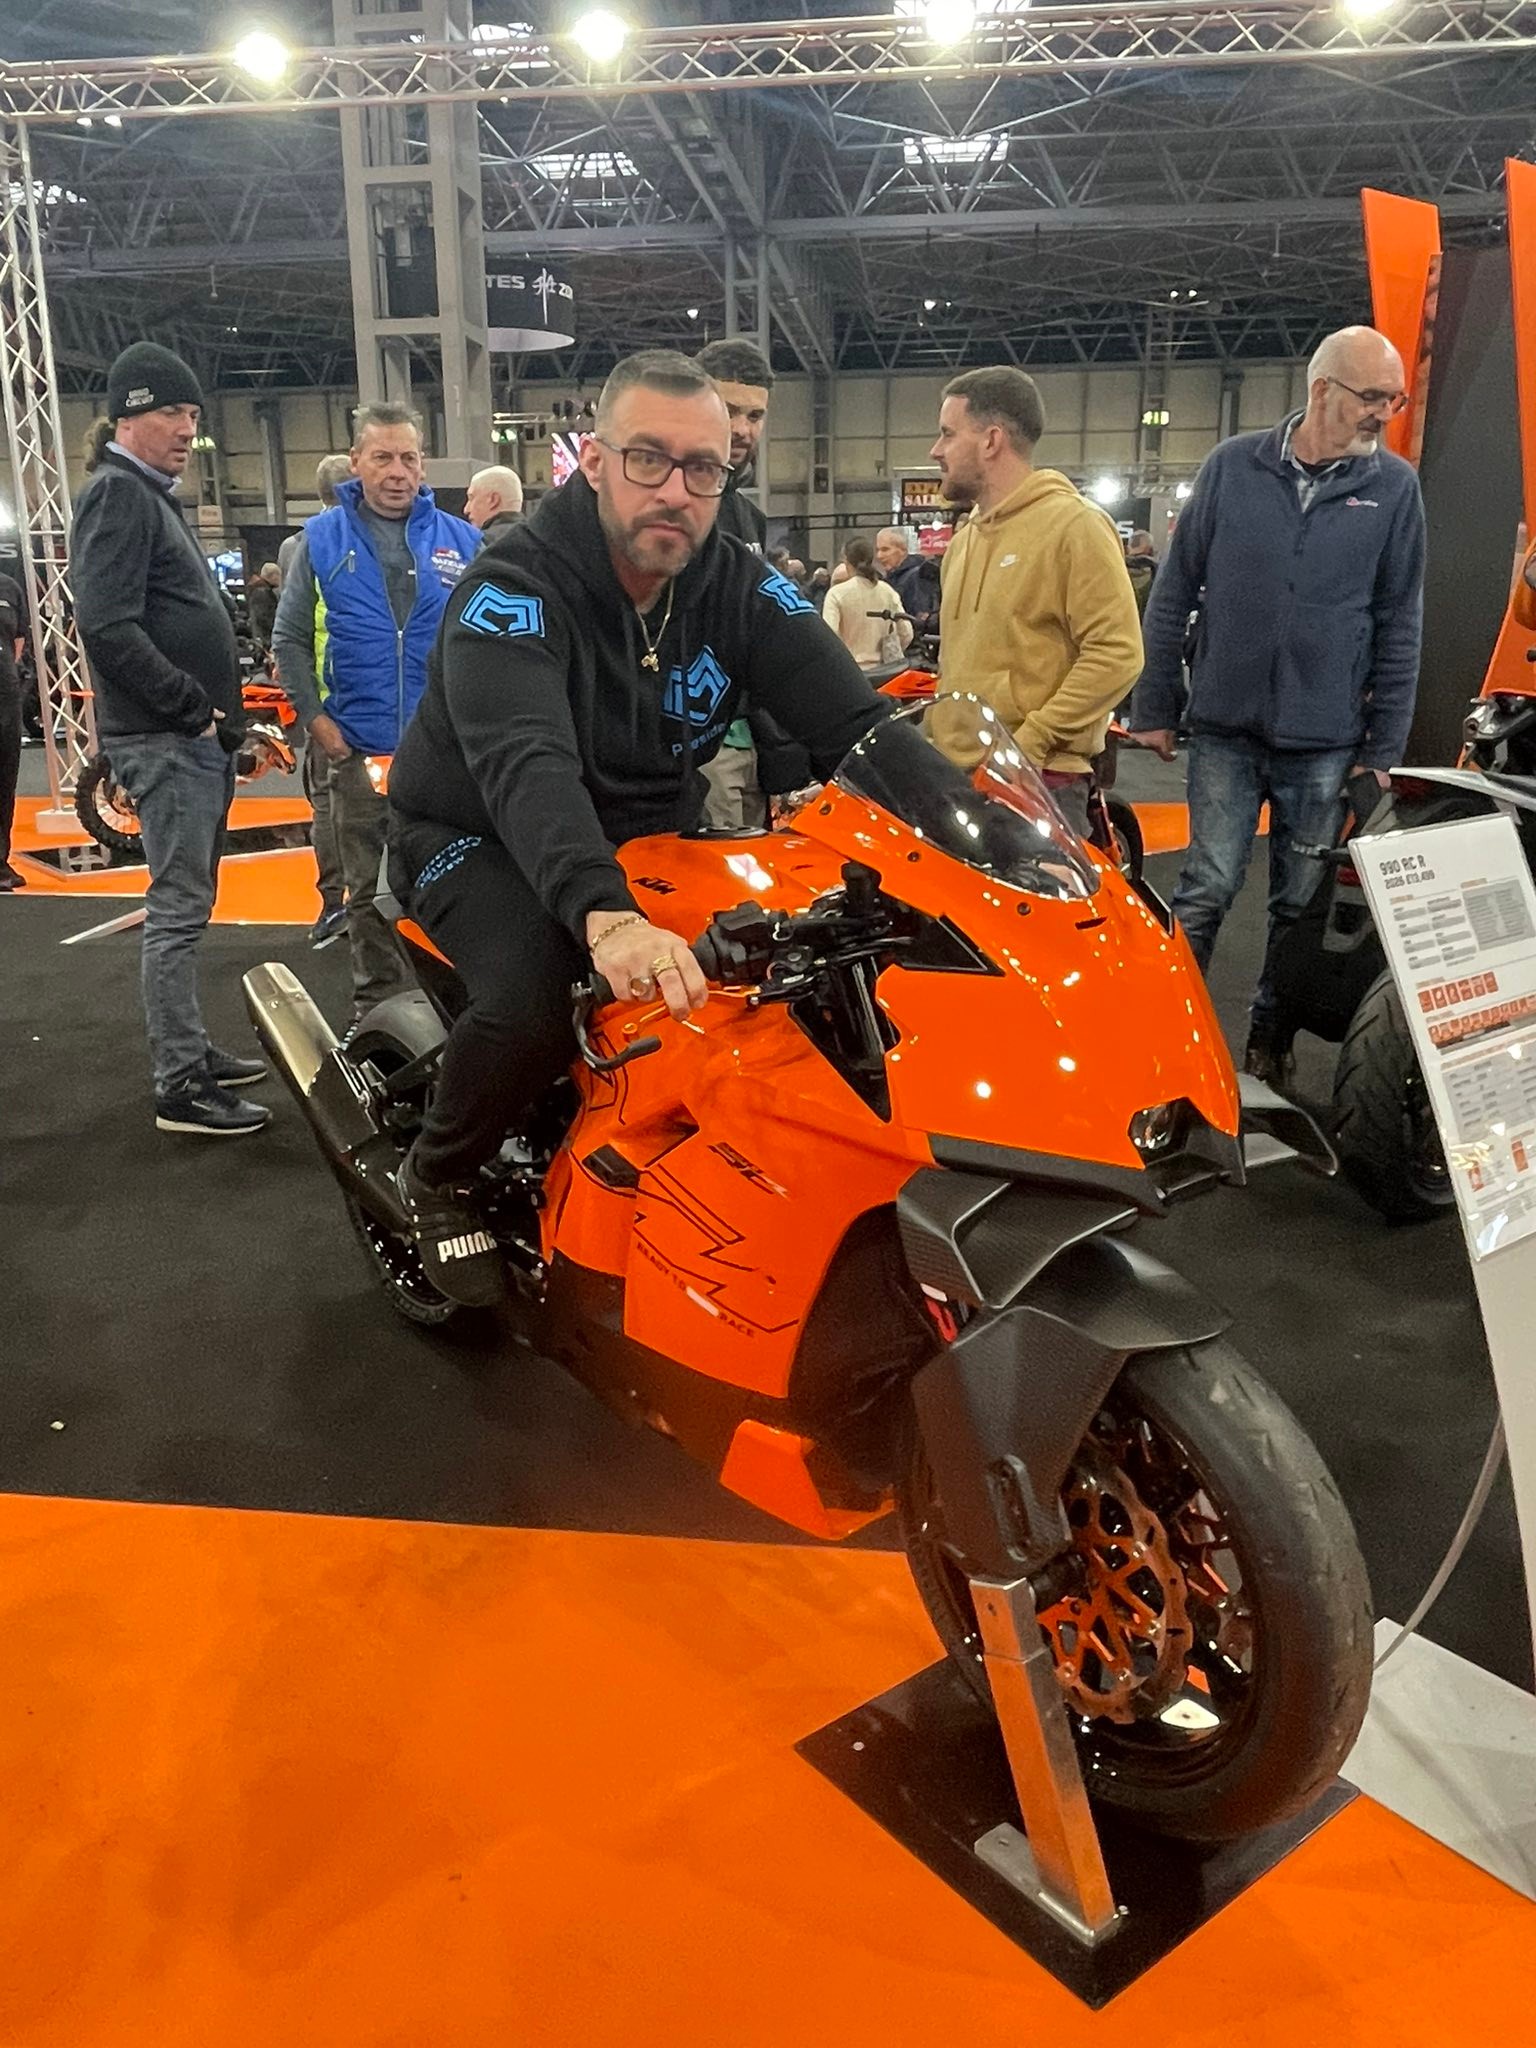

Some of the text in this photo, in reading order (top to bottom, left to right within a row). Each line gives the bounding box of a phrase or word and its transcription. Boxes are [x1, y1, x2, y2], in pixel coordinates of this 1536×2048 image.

[1379, 854, 1427, 876] 990 RC R
[637, 1241, 756, 1339] READY TO RACE
